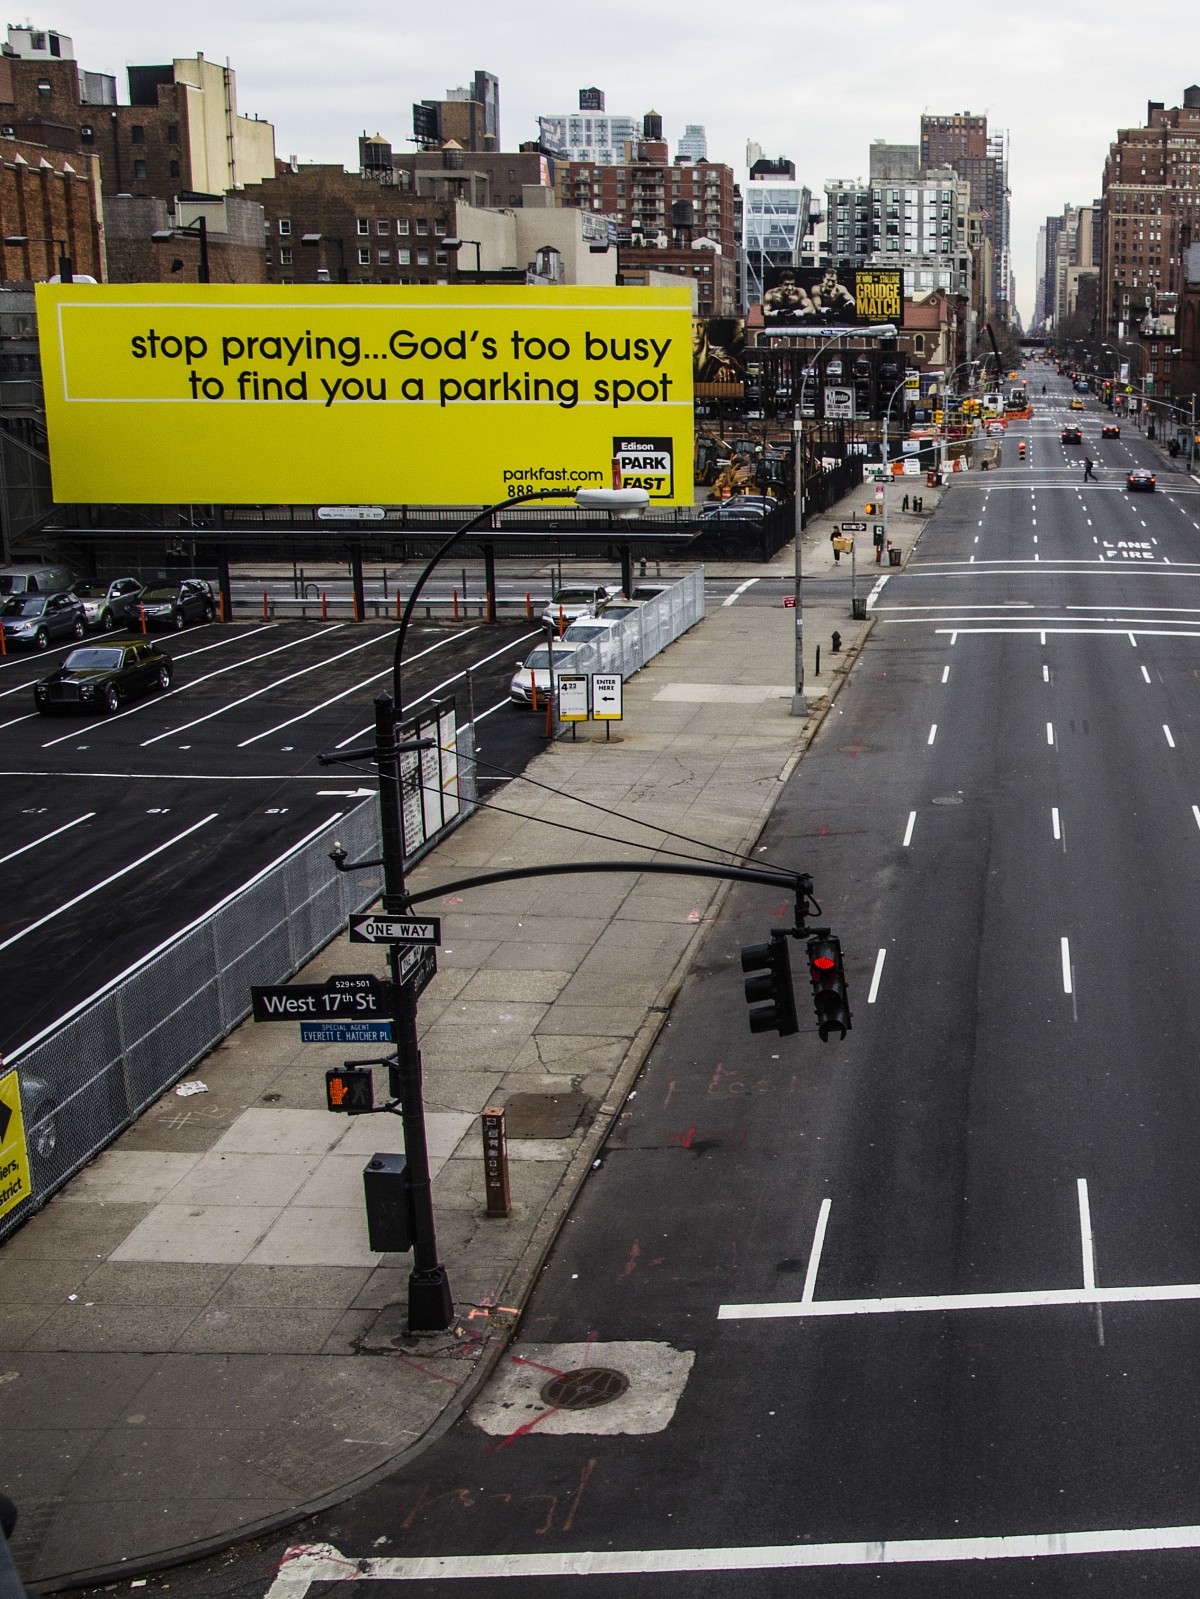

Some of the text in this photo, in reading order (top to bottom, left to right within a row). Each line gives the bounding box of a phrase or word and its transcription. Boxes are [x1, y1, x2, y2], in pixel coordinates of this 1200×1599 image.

[856, 283, 900, 298] GRUDGE
[857, 298, 900, 315] MATCH
[131, 329, 208, 365] stop
[511, 330, 571, 360] too
[585, 331, 673, 368] busy
[189, 370, 673, 409] to find you a parking spot
[621, 442, 654, 451] Edison
[621, 456, 668, 470] PARK
[503, 467, 603, 483] parkfast.com
[623, 477, 666, 491] FAST
[1102, 541, 1152, 549] LANE
[1106, 550, 1155, 559] FIRE
[366, 923, 428, 937] ONE WAY
[263, 992, 377, 1013] West 17th St
[350, 1023, 370, 1031] AGENT
[303, 1031, 390, 1041] EVERETT E HATCHER PL
